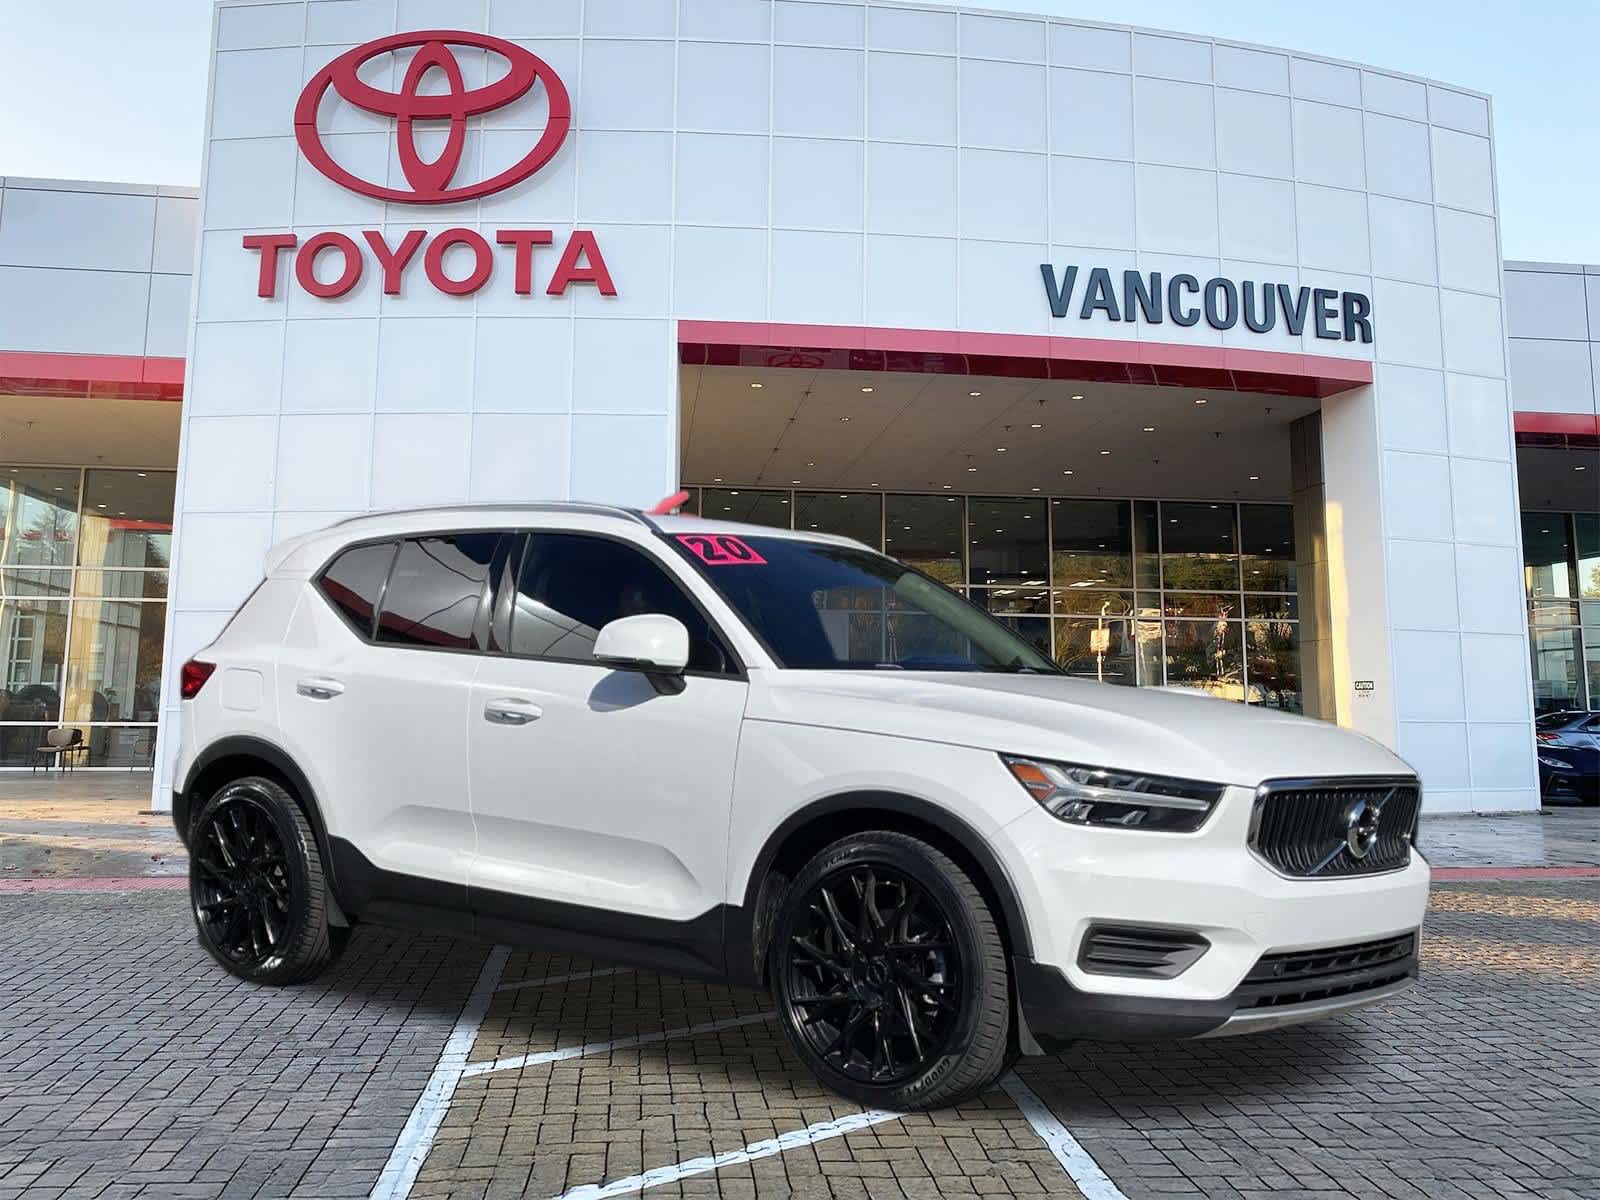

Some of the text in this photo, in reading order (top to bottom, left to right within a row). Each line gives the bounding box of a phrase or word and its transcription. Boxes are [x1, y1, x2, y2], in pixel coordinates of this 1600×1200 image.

[243, 228, 617, 298] TOYOTA
[1040, 264, 1373, 343] VANCOUVER
[684, 536, 753, 560] 20
